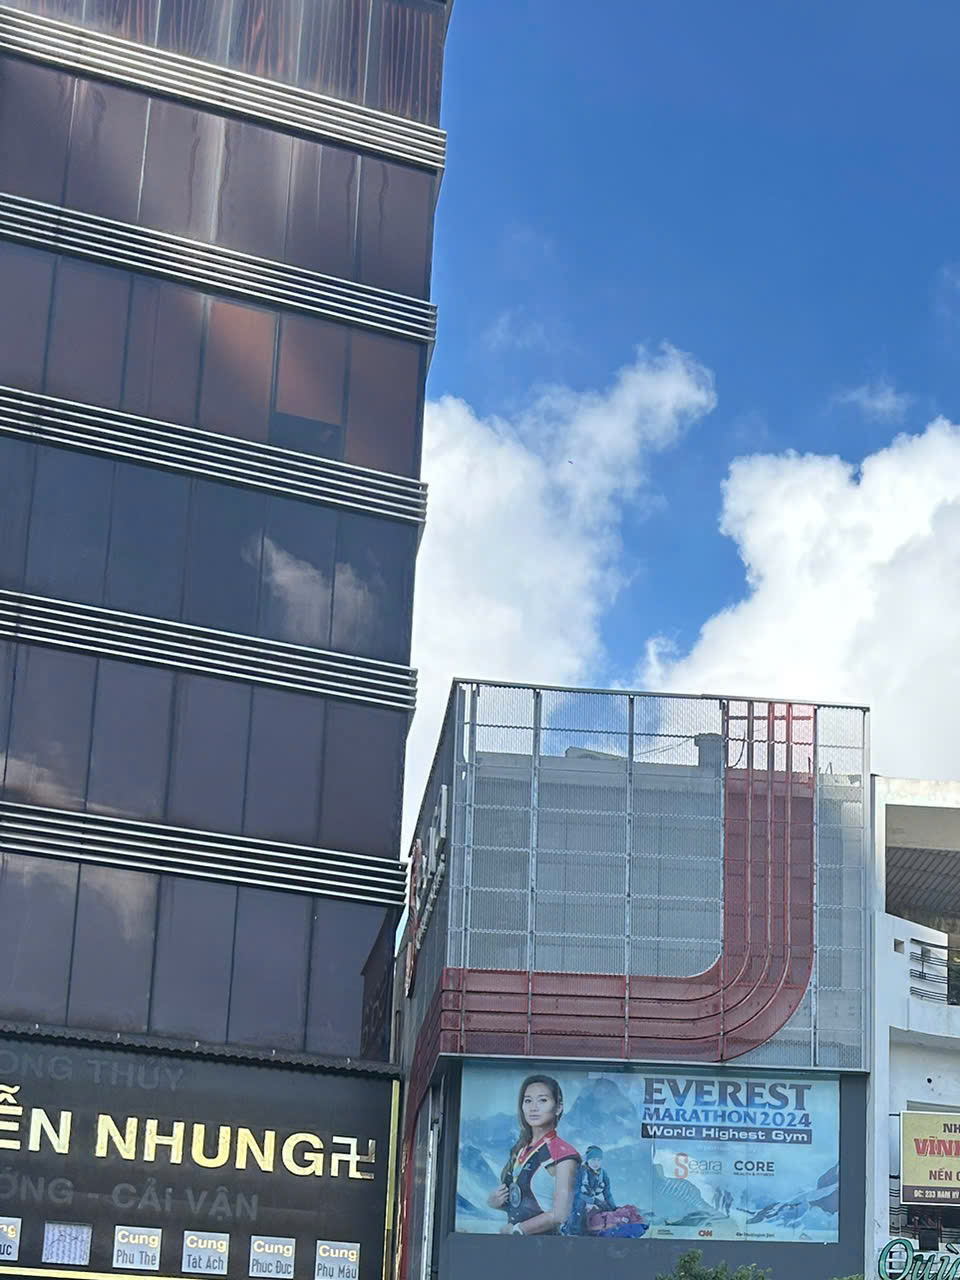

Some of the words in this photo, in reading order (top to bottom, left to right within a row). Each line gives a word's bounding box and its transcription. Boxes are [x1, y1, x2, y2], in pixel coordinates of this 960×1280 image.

[643, 1077, 812, 1110] EVEREST
[642, 1107, 757, 1125] MARATHON
[761, 1112, 812, 1127] 2024
[648, 1125, 696, 1137] World
[702, 1128, 766, 1140] Highest
[772, 1130, 808, 1143] Gym
[95, 1113, 324, 1177] NHUNG
[674, 1152, 722, 1180] Seara
[734, 1160, 775, 1172] CORE
[112, 1177, 174, 1213] CẢI
[185, 1186, 259, 1221] VẬN
[117, 1230, 160, 1249] Cung
[186, 1235, 228, 1252] Cung
[253, 1240, 294, 1257] Cung
[319, 1245, 358, 1262] Cung
